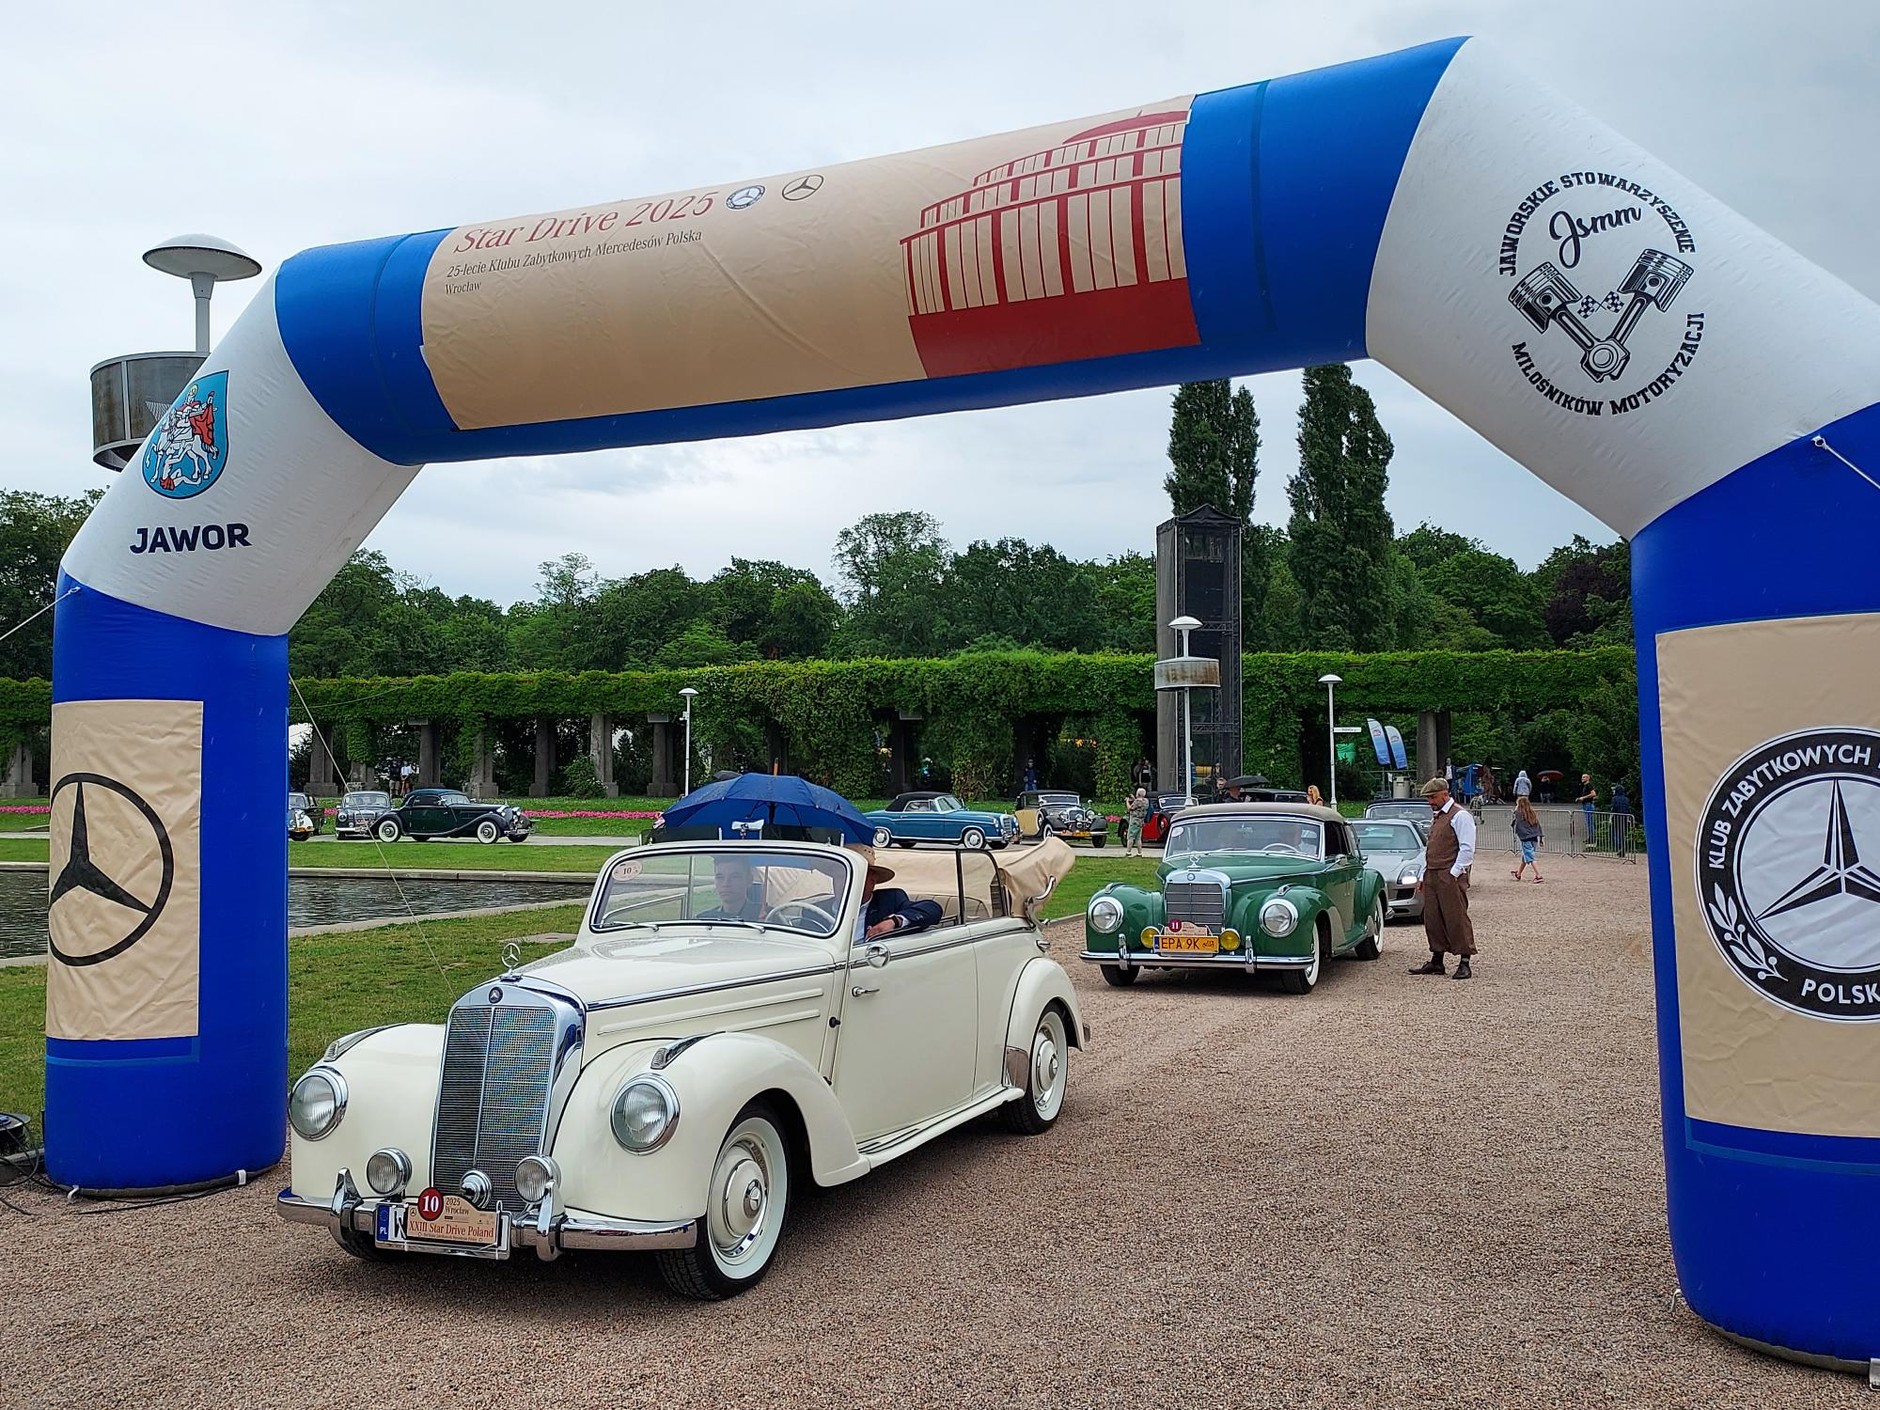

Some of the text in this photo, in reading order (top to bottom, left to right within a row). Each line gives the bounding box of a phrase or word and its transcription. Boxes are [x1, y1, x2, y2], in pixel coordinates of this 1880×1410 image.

[453, 226, 525, 254] Star
[525, 211, 619, 243] Drive
[625, 191, 719, 227] 2025
[1499, 171, 1696, 276] JAWORSKIE STOWARZYSZENIE
[1549, 206, 1642, 270] Jsmm
[447, 229, 702, 278] 25-lecie Klubu Zabytkowych Mercedesów Polska
[445, 281, 482, 295] Wrocław
[1609, 312, 1705, 415] MOTORYZACJI
[130, 522, 252, 554] JAWOR
[1708, 744, 1872, 869] KLUB ZABYTKOWYCH
[1171, 922, 1179, 930] 11
[1161, 937, 1200, 950] EPA 9K
[422, 1195, 440, 1213] 10
[380, 1226, 388, 1235] PL
[429, 1222, 444, 1233] Star
[446, 1224, 466, 1236] Drive
[467, 1226, 494, 1238] Poland
